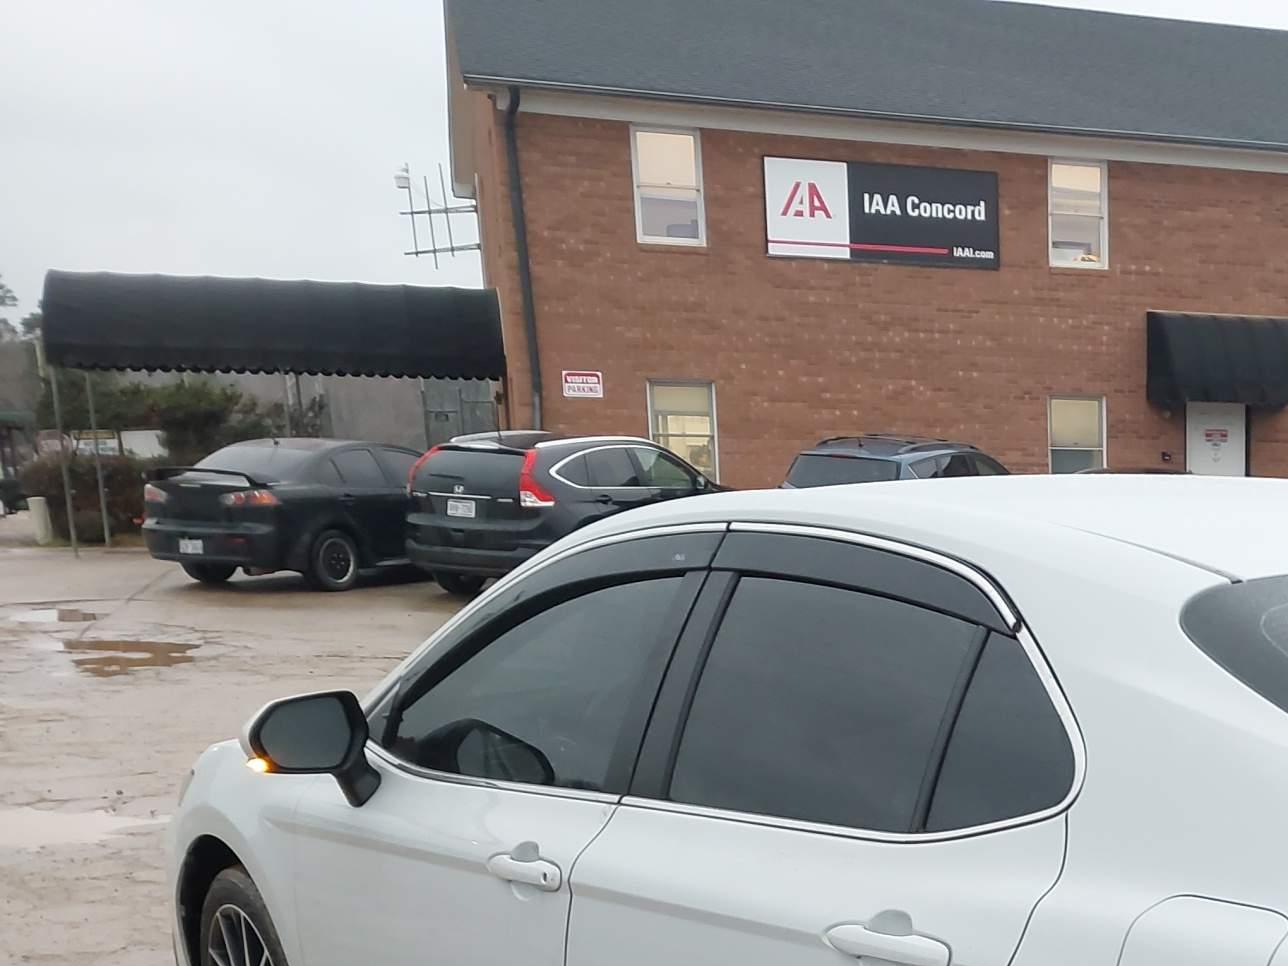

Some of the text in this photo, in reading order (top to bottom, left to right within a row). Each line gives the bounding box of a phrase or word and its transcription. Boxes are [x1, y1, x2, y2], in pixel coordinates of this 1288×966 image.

[863, 192, 986, 221] IAA Concord
[952, 246, 995, 259] IAAI.com
